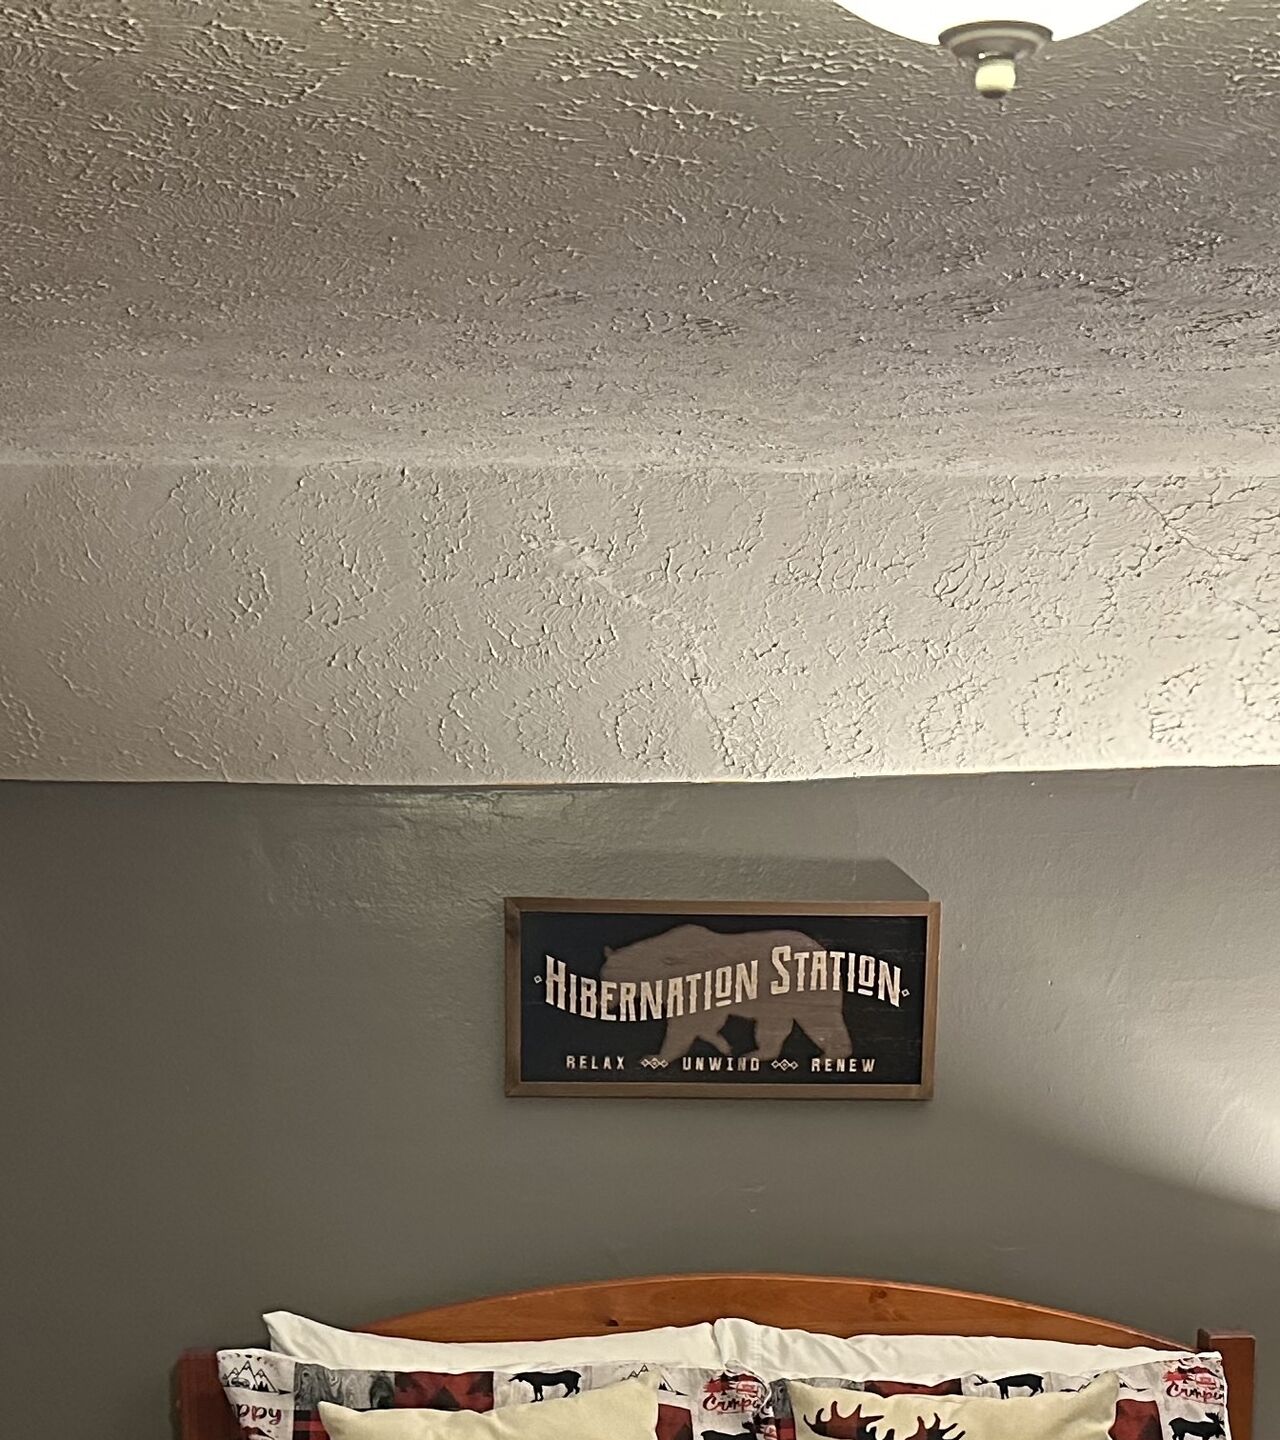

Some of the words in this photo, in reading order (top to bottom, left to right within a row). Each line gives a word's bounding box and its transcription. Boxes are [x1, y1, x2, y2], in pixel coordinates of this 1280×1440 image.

[545, 954, 759, 1022] HIBERNATION
[770, 945, 902, 1008] STATION
[565, 1055, 625, 1071] RELAX
[682, 1056, 760, 1072] UNWIND
[810, 1057, 876, 1073] RENEW
